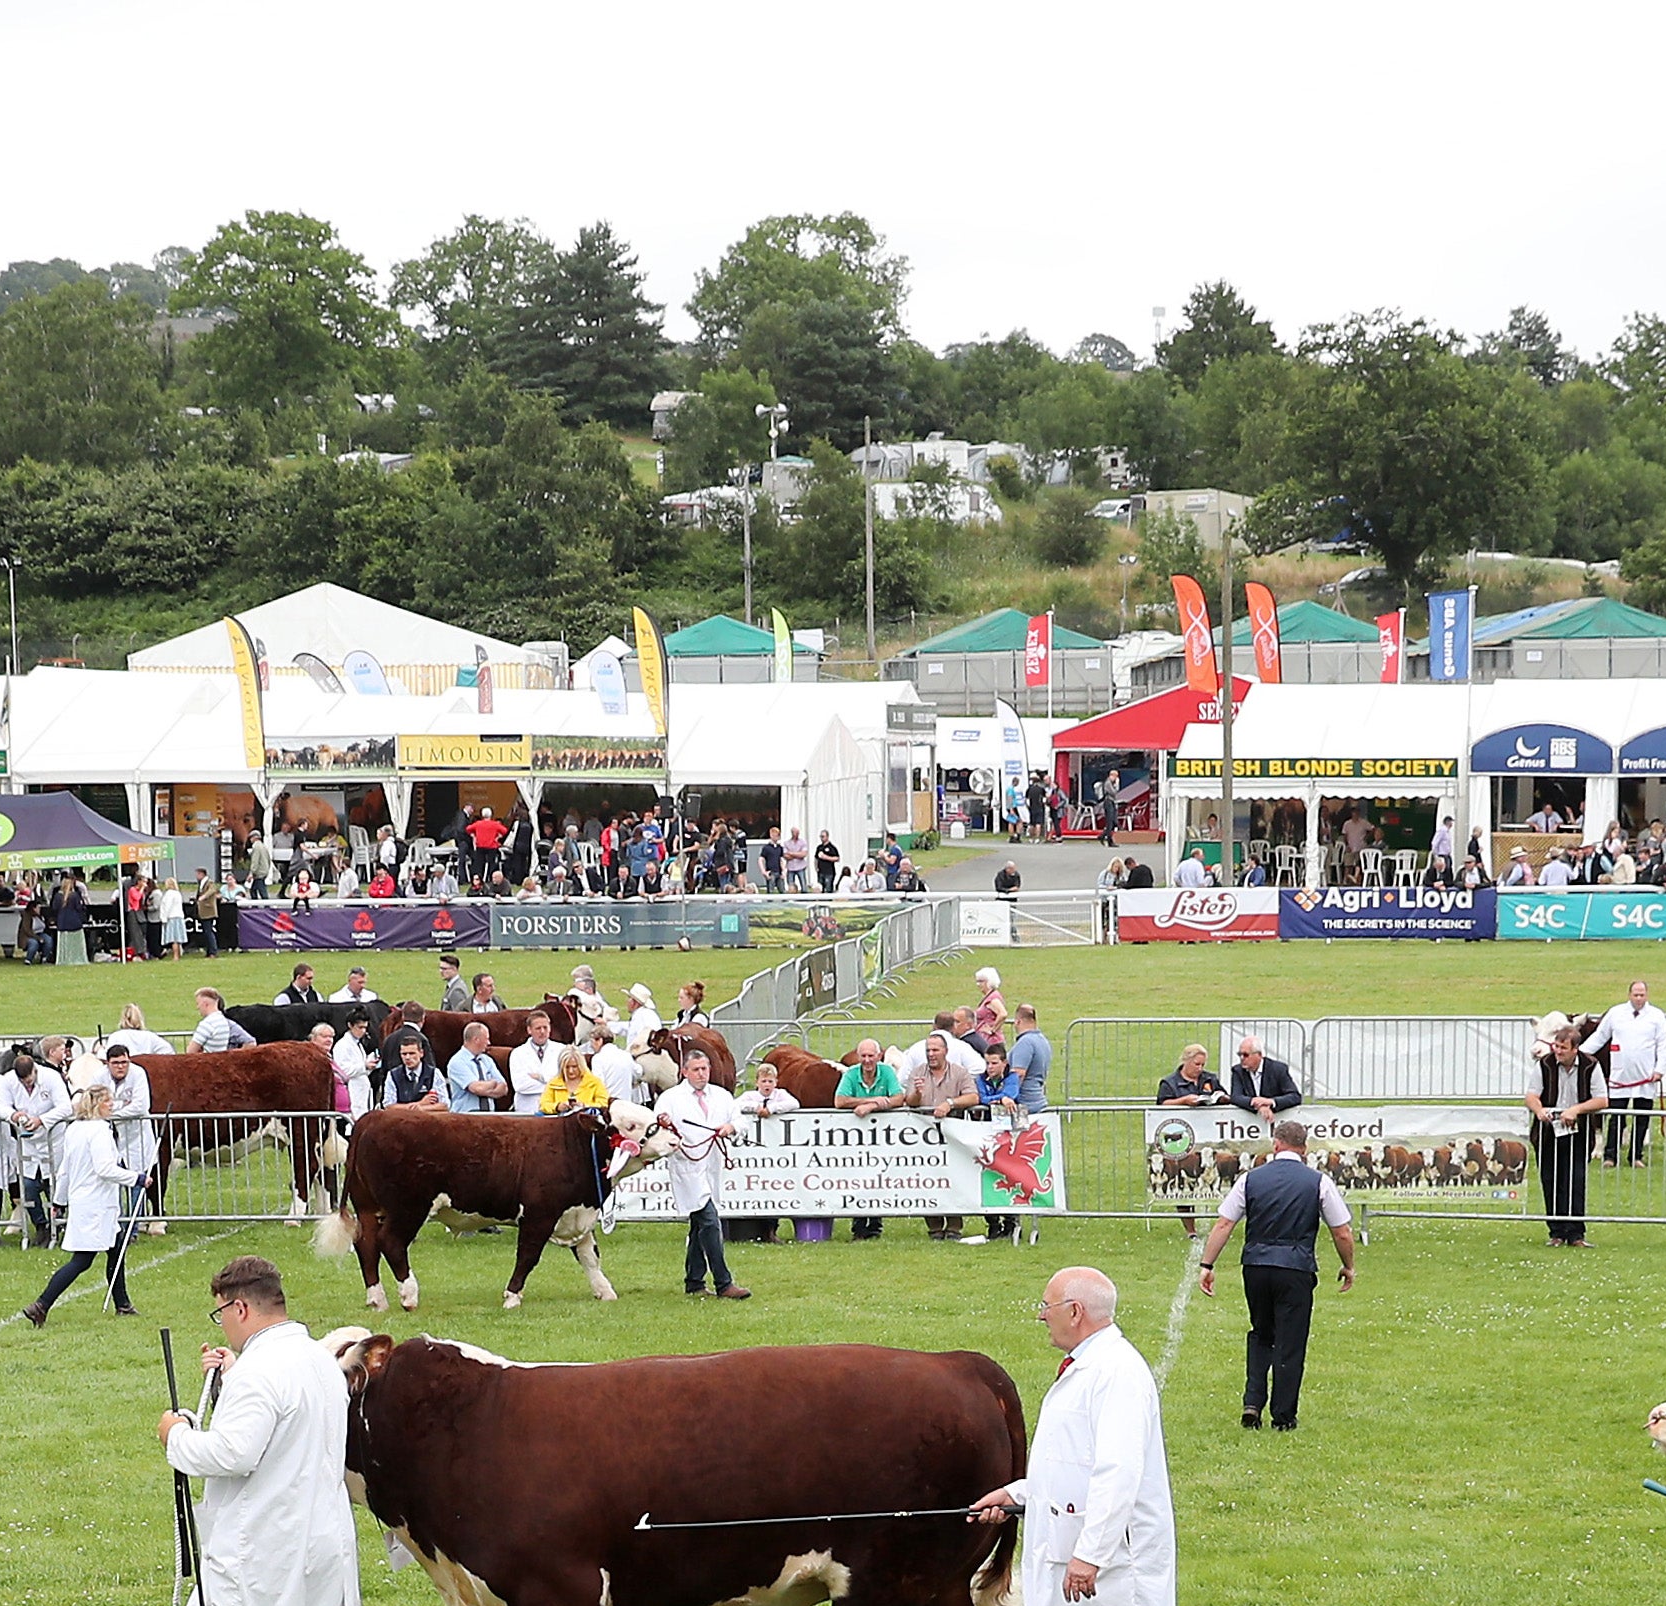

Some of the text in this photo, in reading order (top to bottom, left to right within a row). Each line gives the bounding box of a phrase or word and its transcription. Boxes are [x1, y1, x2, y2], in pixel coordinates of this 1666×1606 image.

[405, 747, 523, 763] LIMOUSIN
[1506, 755, 1546, 768] Genus
[1622, 758, 1649, 769] Profit
[1176, 760, 1454, 776] BRITSH BLONDE SOCIETY
[1322, 888, 1472, 914] Agri Lloyd
[500, 915, 622, 935] FORSTERS
[1322, 918, 1472, 930] THE SECRET'S IN THE SCIENCE
[1514, 904, 1566, 928] S4C
[1612, 904, 1663, 928] S4C
[779, 1118, 948, 1148] Limited
[1215, 1120, 1261, 1140] The
[1270, 1118, 1383, 1140] reford
[807, 1151, 948, 1173] Annibynnol
[725, 1179, 737, 1190] a
[745, 1174, 795, 1190] Free
[803, 1173, 951, 1190] Consultation
[720, 1199, 801, 1210] surance
[841, 1196, 938, 1210] Pensions
